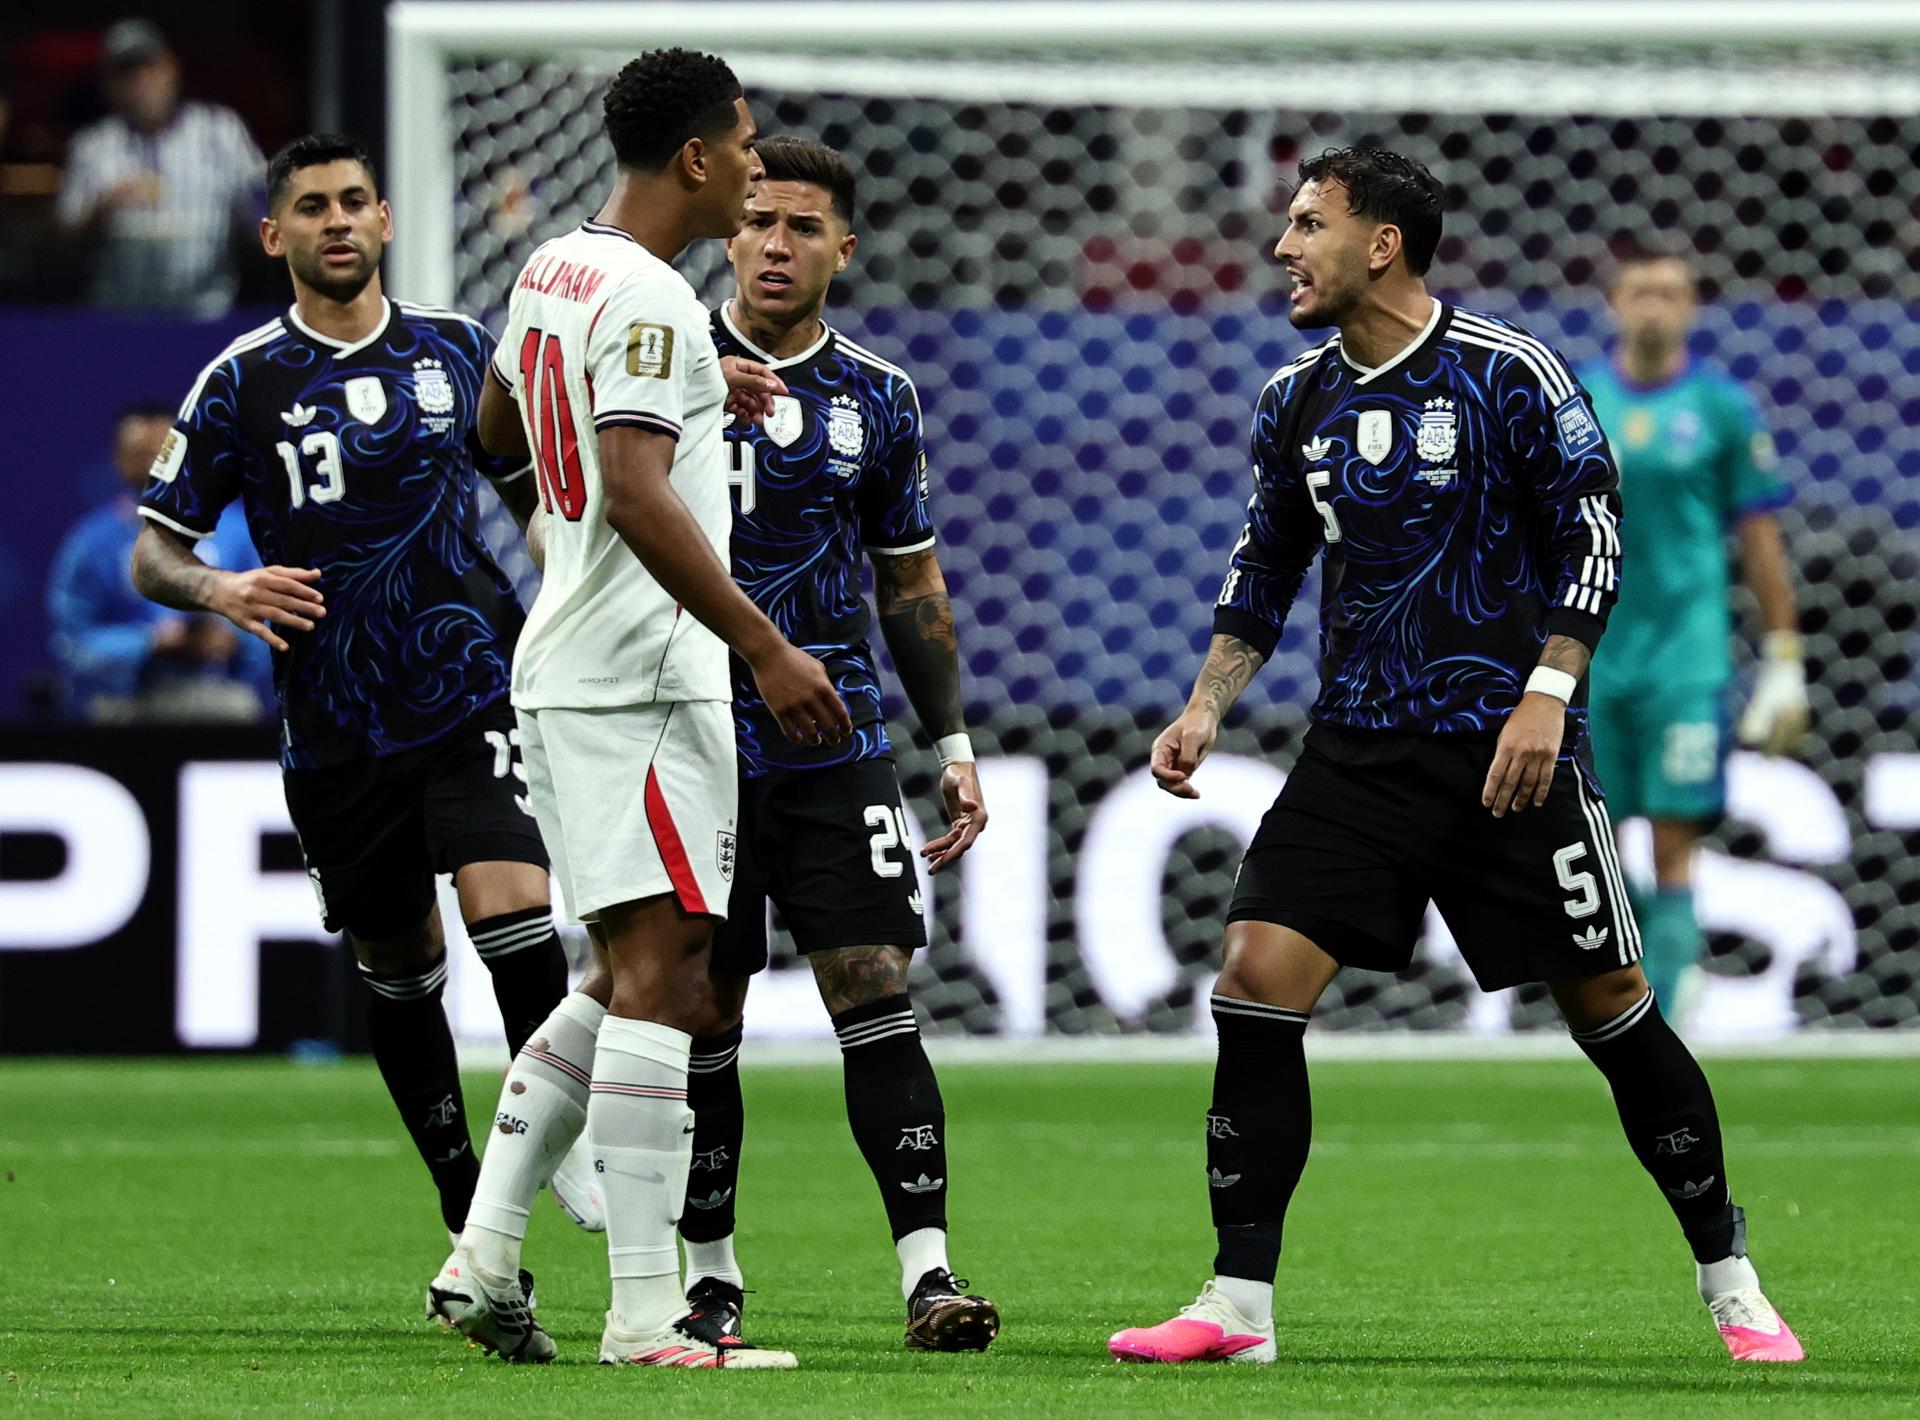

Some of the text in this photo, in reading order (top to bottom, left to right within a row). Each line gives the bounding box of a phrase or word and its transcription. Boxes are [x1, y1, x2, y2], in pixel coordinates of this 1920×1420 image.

[519, 326, 588, 520] 10
[1425, 425, 1447, 447] AFA
[276, 431, 346, 510] 13
[1306, 470, 1342, 543] 5
[1552, 841, 1601, 919] 5
[895, 1124, 939, 1150] AFA
